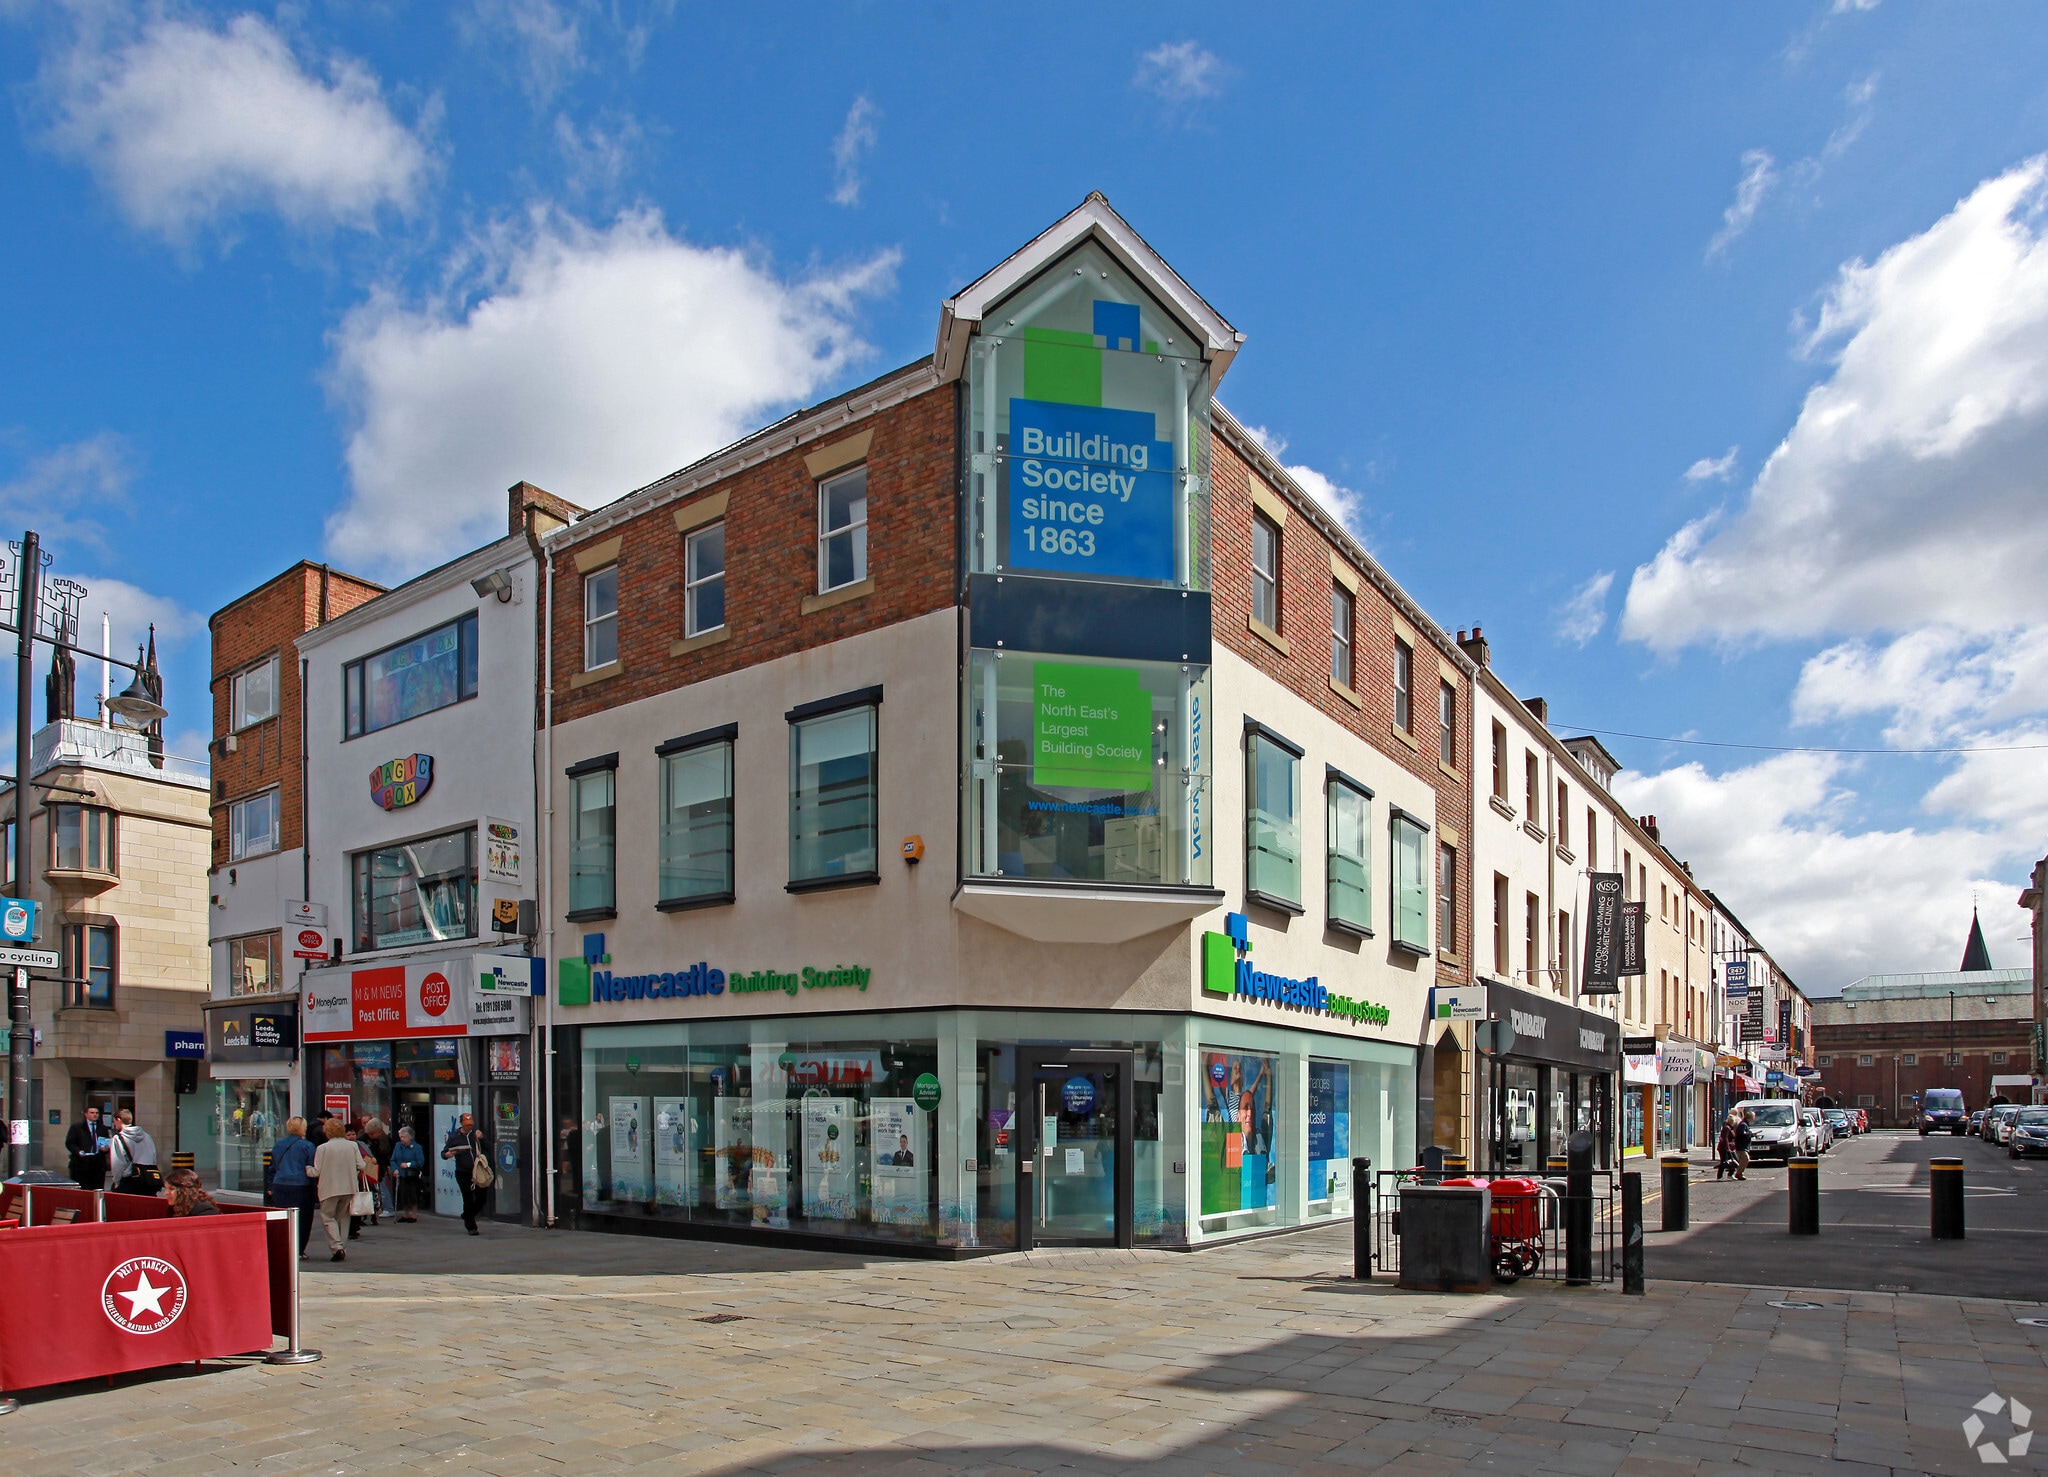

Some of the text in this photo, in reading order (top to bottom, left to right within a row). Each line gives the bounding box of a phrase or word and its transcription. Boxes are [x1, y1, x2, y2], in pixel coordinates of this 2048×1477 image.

[1022, 427, 1148, 472] Building
[1022, 460, 1136, 502] Society
[1022, 493, 1104, 525] since
[1023, 525, 1096, 557] 1863
[1041, 684, 1065, 698] The
[1041, 703, 1118, 720] North East's
[1041, 722, 1089, 739] Largest
[1041, 741, 1143, 761] Building Society
[371, 758, 428, 790] MAGIC
[385, 784, 414, 805] BOX
[1028, 800, 1157, 817] www.newcastle.co.uk
[1604, 897, 1614, 926] CLINICS
[301, 938, 320, 946] OFFICE
[303, 933, 318, 941] POST
[1594, 896, 1606, 975] NATIONAL SLIMMING
[1601, 927, 1611, 967] COSMETIC
[11, 953, 53, 965] cycling
[426, 981, 445, 994] POST
[497, 979, 529, 988] Newcastle
[592, 961, 871, 1003] Newcastle Building Society
[356, 984, 403, 1001] M & M NEWS
[1237, 957, 1391, 1026] Newcastle Building Society
[316, 996, 348, 1009] MoneyGram
[423, 994, 448, 1008] OFFICE
[359, 1009, 375, 1022] Post
[378, 1007, 400, 1021] Office
[1510, 1008, 1547, 1040] TONI&GUY
[224, 1036, 241, 1047] Leeds
[255, 1031, 280, 1039] Building
[256, 1036, 280, 1045] Society
[1580, 1027, 1606, 1053] TONI&GUY
[1667, 1056, 1690, 1066] Hays
[1310, 1075, 1330, 1093] hanges
[1310, 1112, 1327, 1125] castle
[442, 1169, 454, 1180] Play
[116, 1260, 168, 1279] PRET A MANGER
[106, 1294, 128, 1326] PIONEERING
[126, 1322, 154, 1332] NATURAL
[154, 1316, 170, 1328] FOOD
[168, 1302, 182, 1318] SINCE
